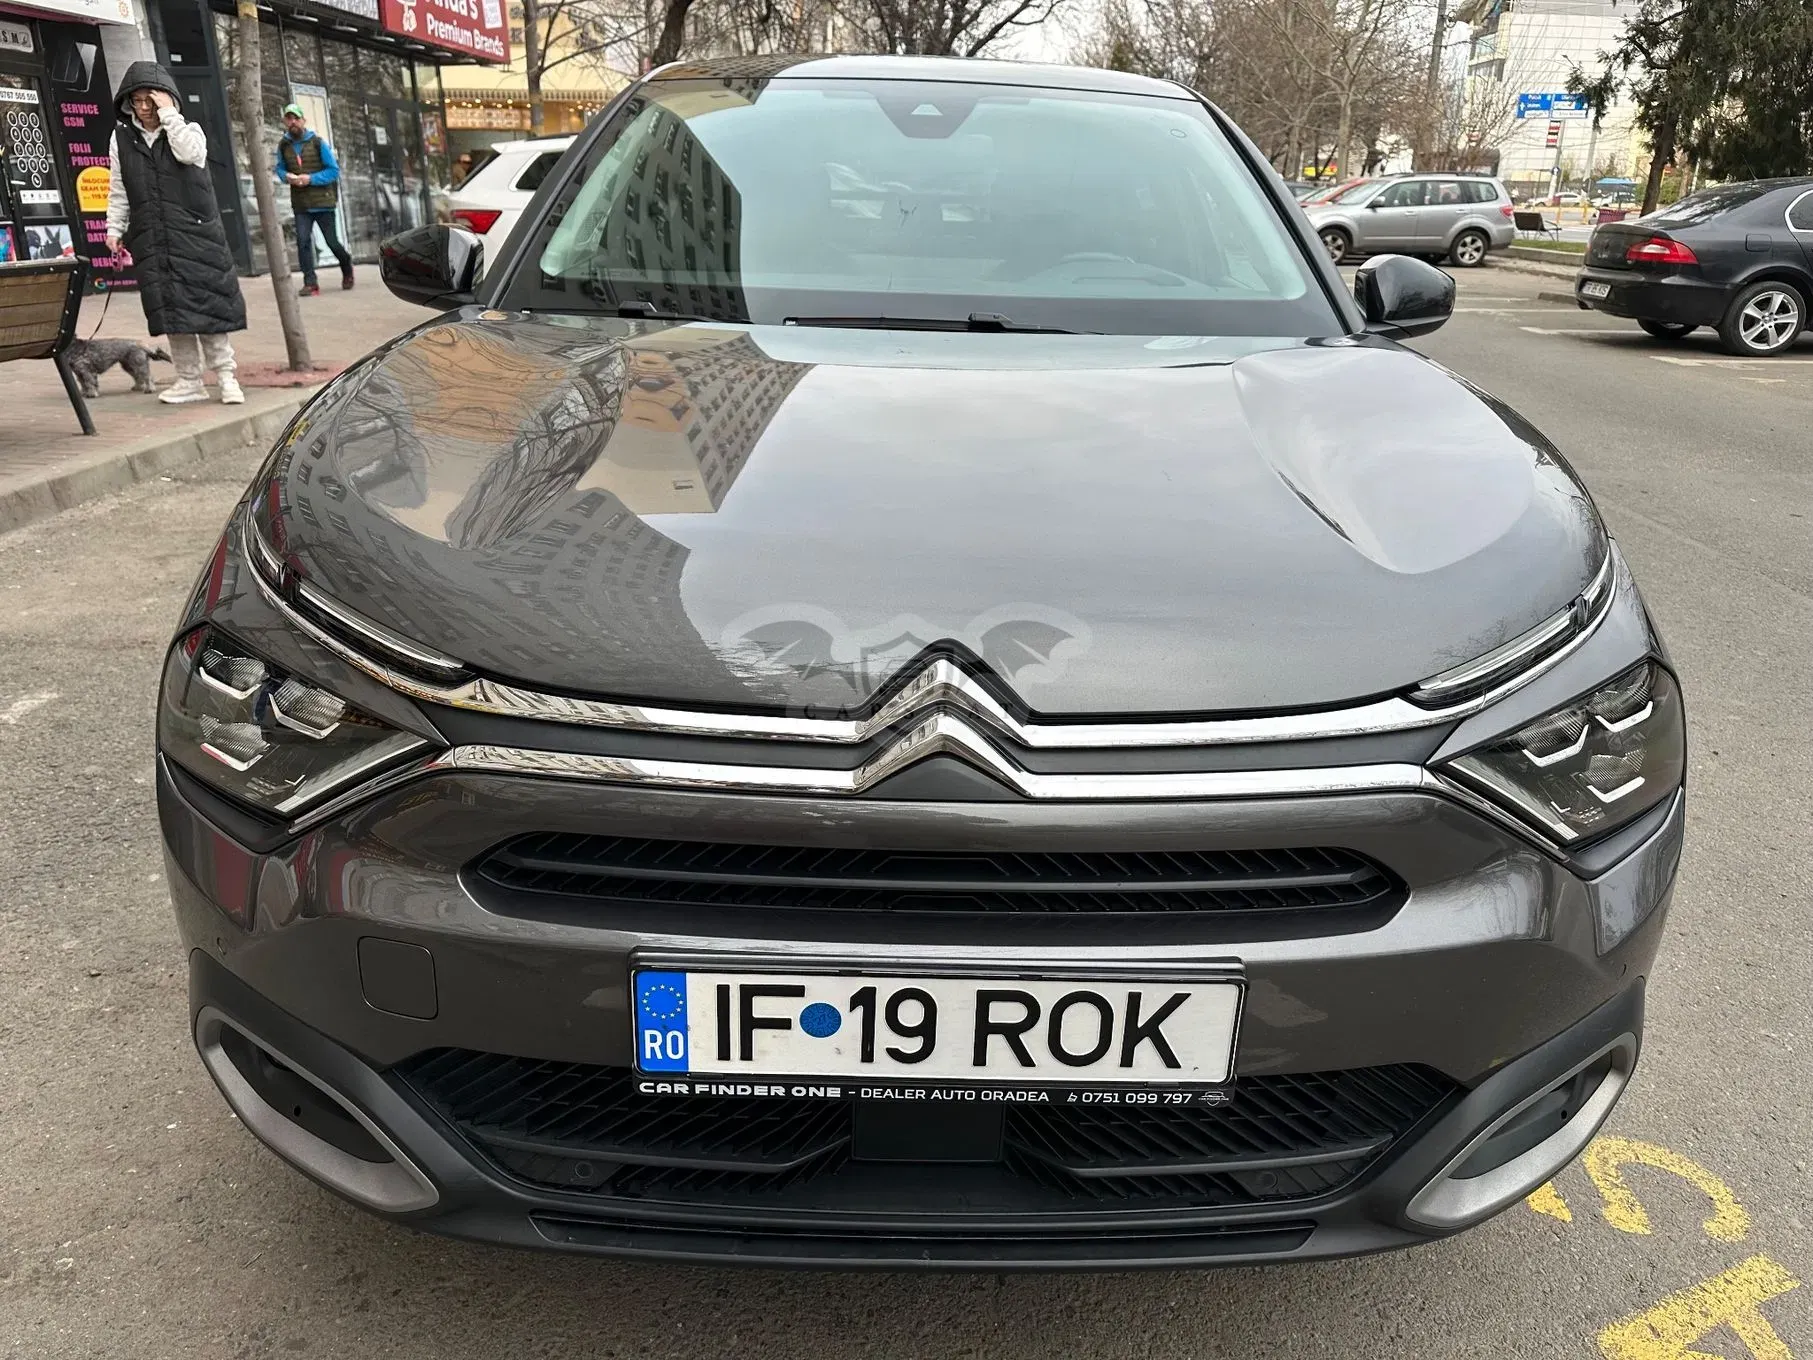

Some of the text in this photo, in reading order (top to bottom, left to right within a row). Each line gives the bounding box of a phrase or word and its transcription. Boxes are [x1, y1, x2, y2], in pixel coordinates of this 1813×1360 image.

[426, 12, 473, 48] Premium
[473, 28, 505, 57] Brands
[60, 103, 100, 115] SERVICE
[63, 116, 85, 127] GSM
[68, 142, 92, 153] FOLII
[716, 984, 1192, 1069] IF 19 ROK
[644, 1030, 684, 1060] RO
[639, 1082, 689, 1094] CAR
[694, 1084, 786, 1096] FINDER
[791, 1086, 841, 1097] ONE
[861, 1088, 926, 1099] DEALER
[930, 1089, 976, 1100] AUTO
[981, 1090, 1050, 1102] ORADEA
[1082, 1092, 1120, 1103] 0751
[1125, 1093, 1157, 1104] 099
[1163, 1093, 1193, 1104] 797
